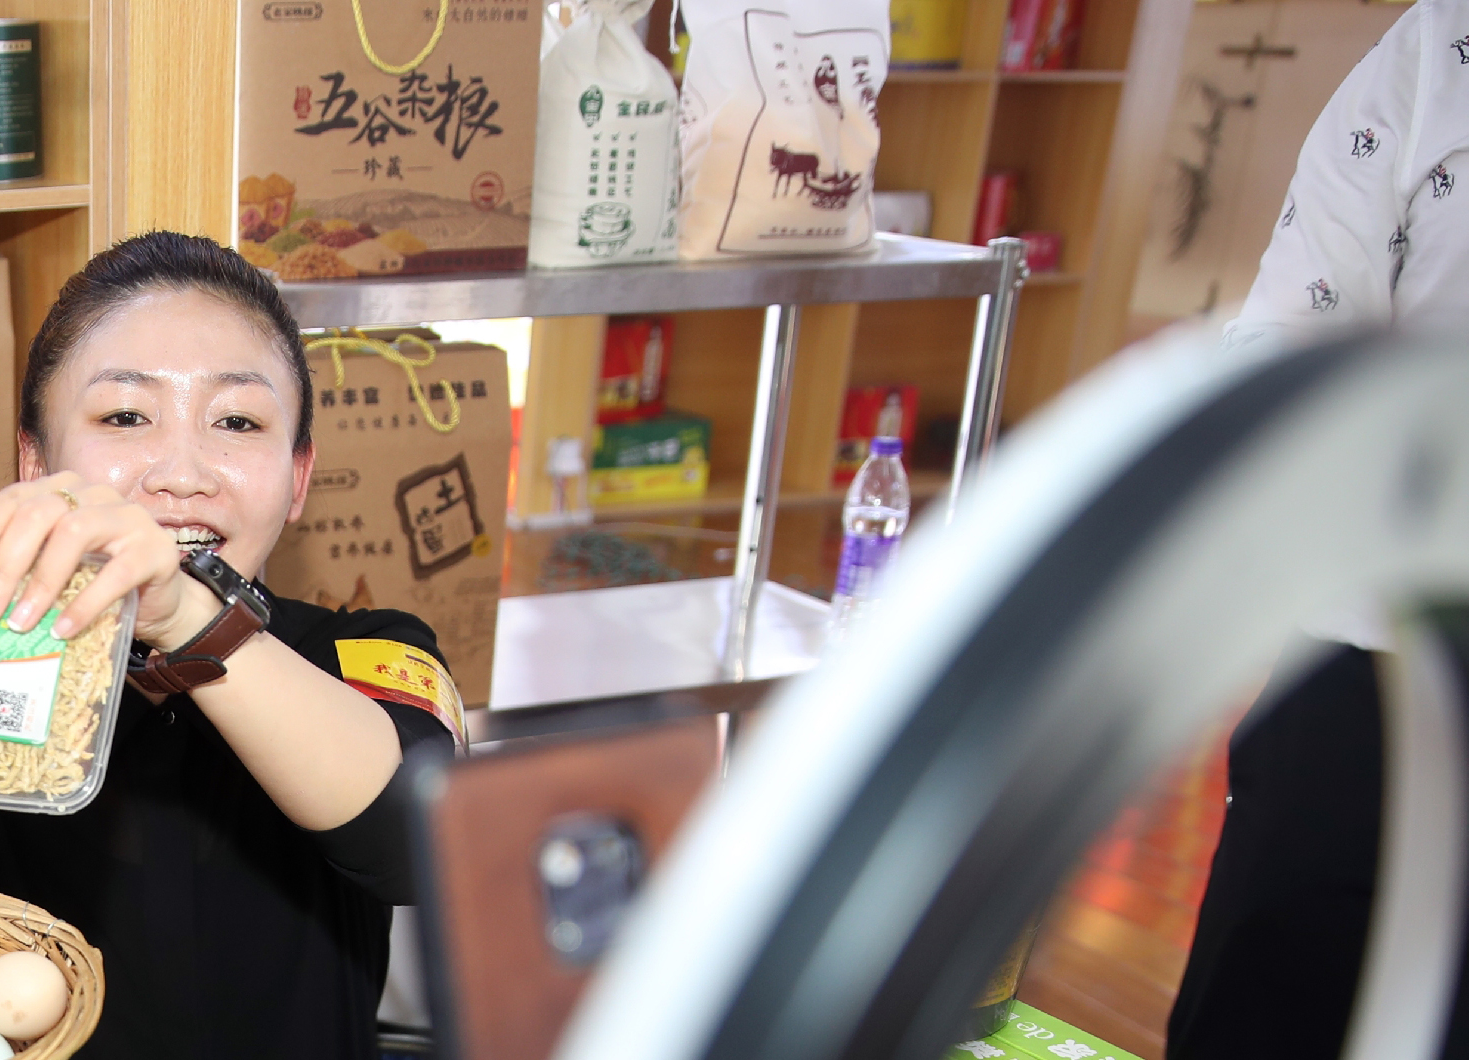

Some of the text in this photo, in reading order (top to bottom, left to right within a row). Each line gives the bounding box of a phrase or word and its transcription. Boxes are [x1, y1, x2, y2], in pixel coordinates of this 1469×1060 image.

[294, 63, 503, 160] 五谷杂粮
[363, 155, 404, 181] 珍藏
